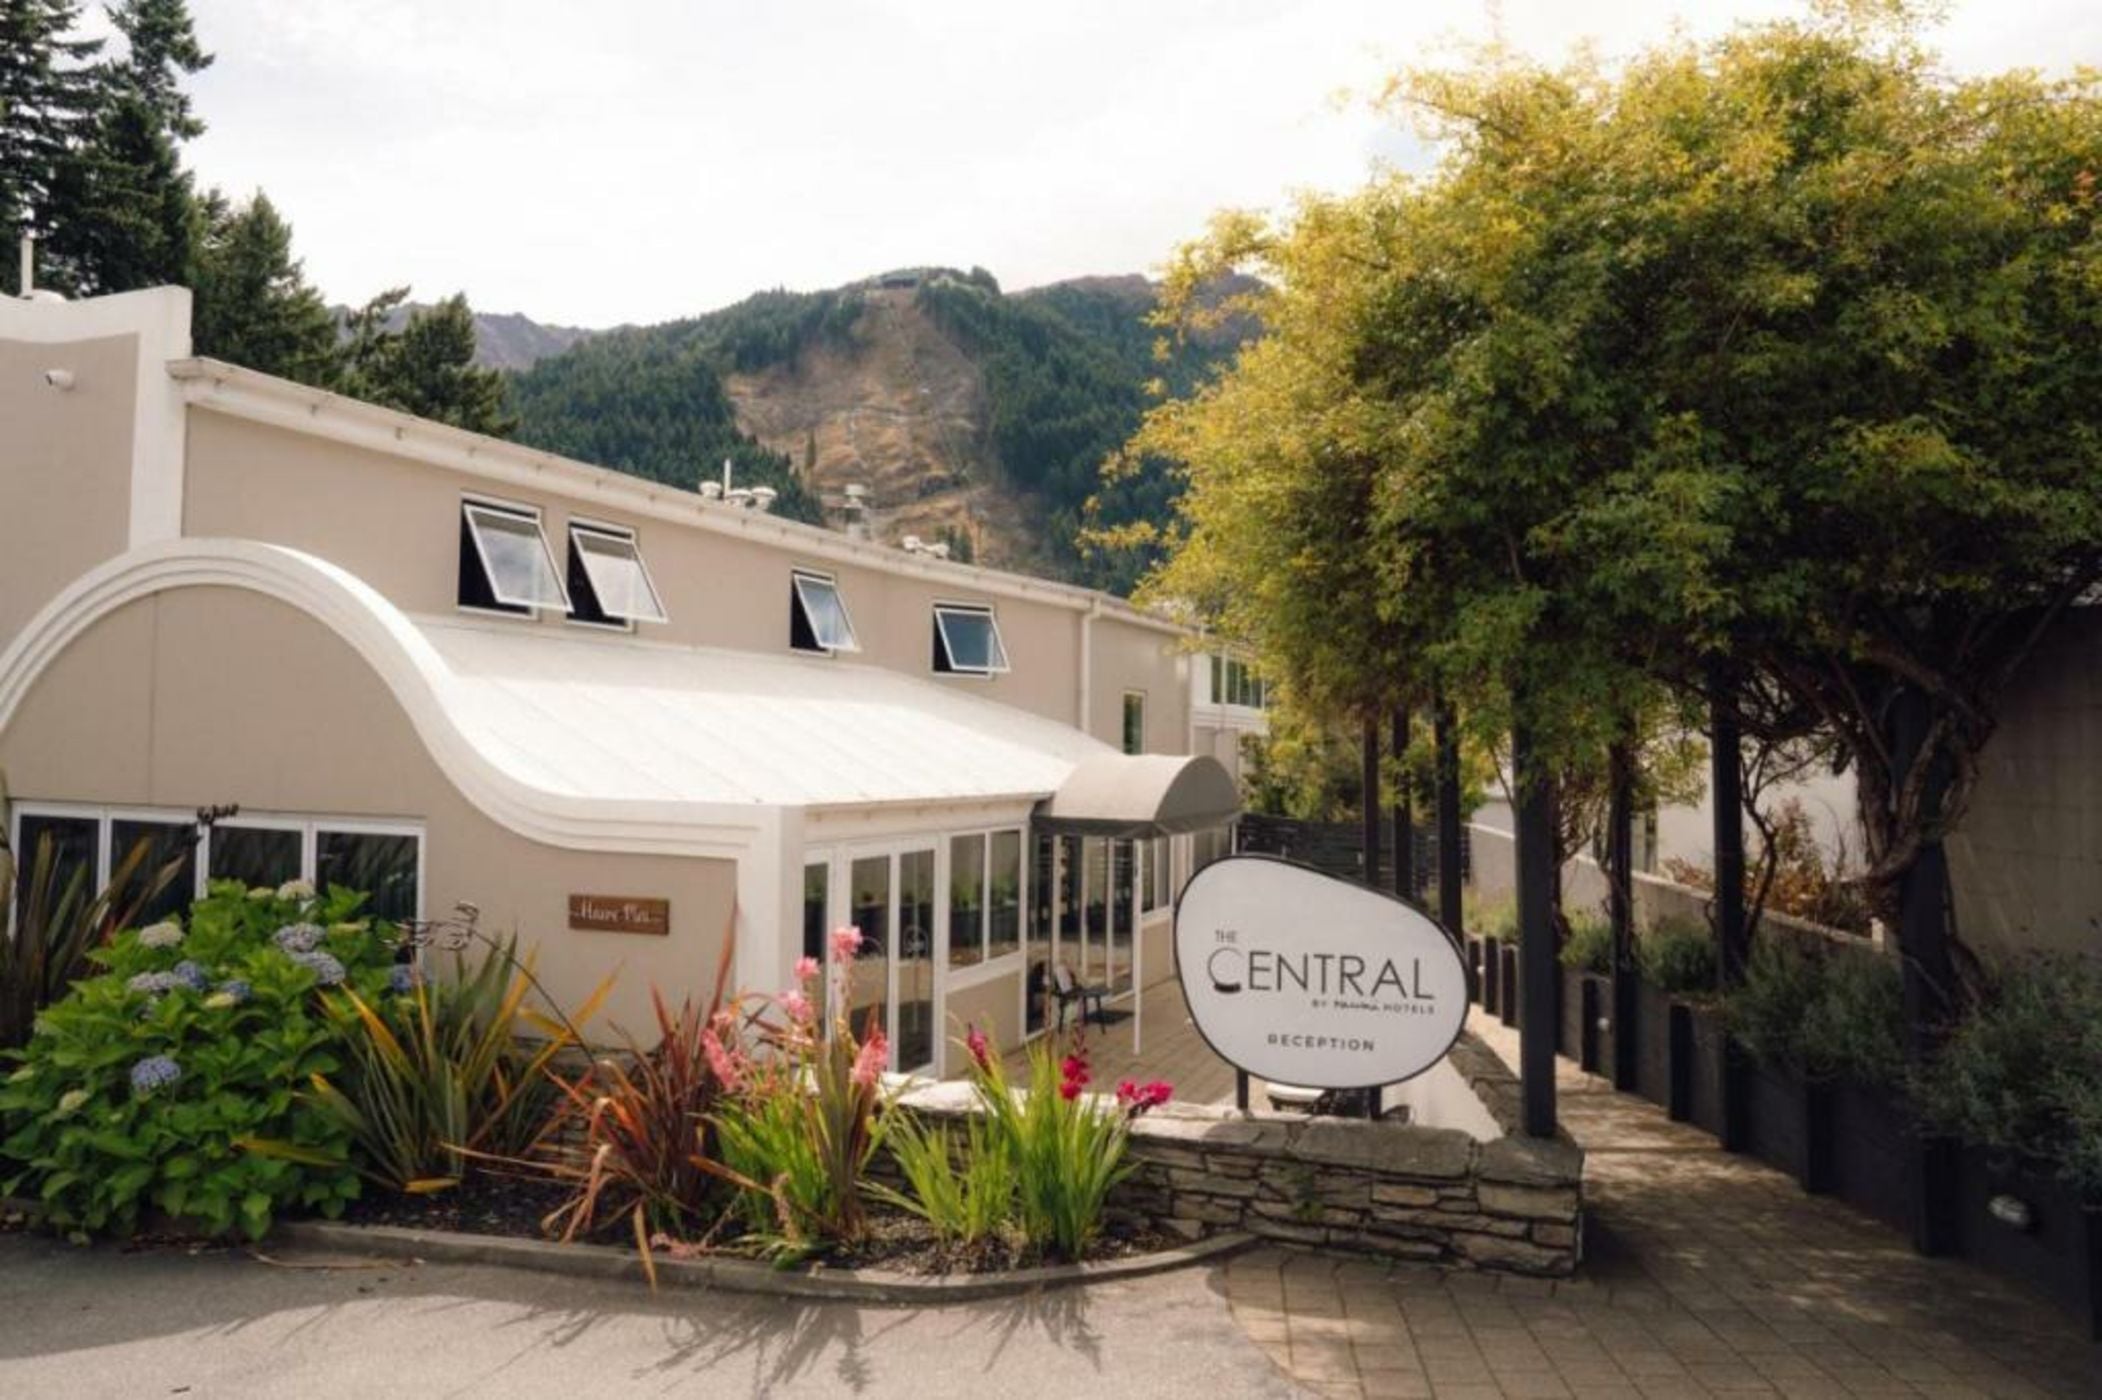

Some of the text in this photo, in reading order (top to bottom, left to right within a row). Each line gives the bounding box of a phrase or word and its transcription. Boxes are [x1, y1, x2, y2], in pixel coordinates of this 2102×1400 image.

[1215, 930, 1238, 943] THE
[1207, 947, 1435, 1000] CENTRAL
[1383, 1003, 1435, 1015] HOTELS
[1267, 1033, 1375, 1052] RECEPTION
